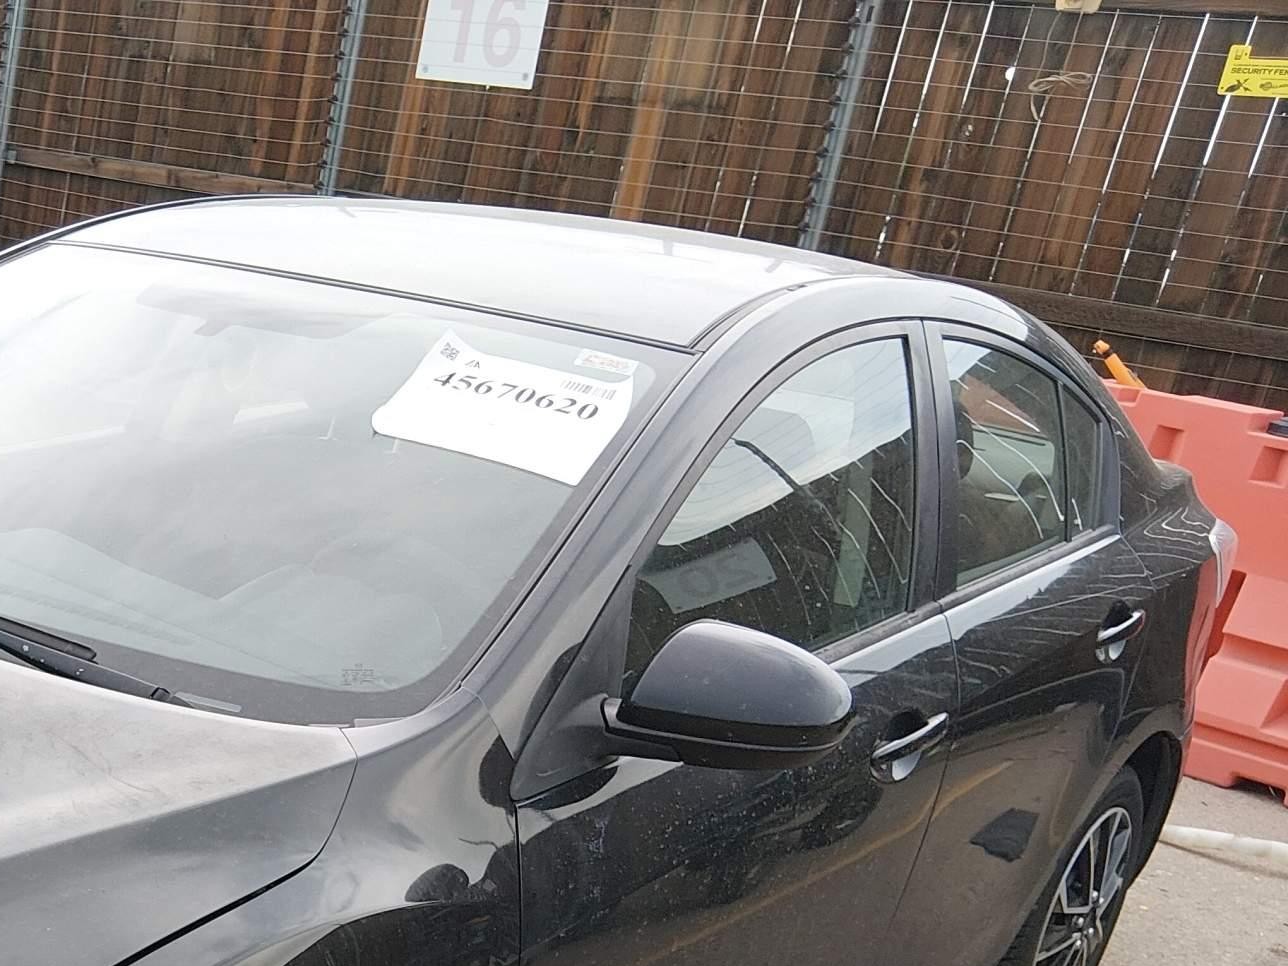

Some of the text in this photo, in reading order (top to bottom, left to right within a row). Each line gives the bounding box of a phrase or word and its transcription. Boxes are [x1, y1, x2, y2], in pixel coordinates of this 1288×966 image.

[450, 0, 528, 67] 16
[1230, 67, 1274, 75] SECURITY
[432, 371, 600, 421] 45670620
